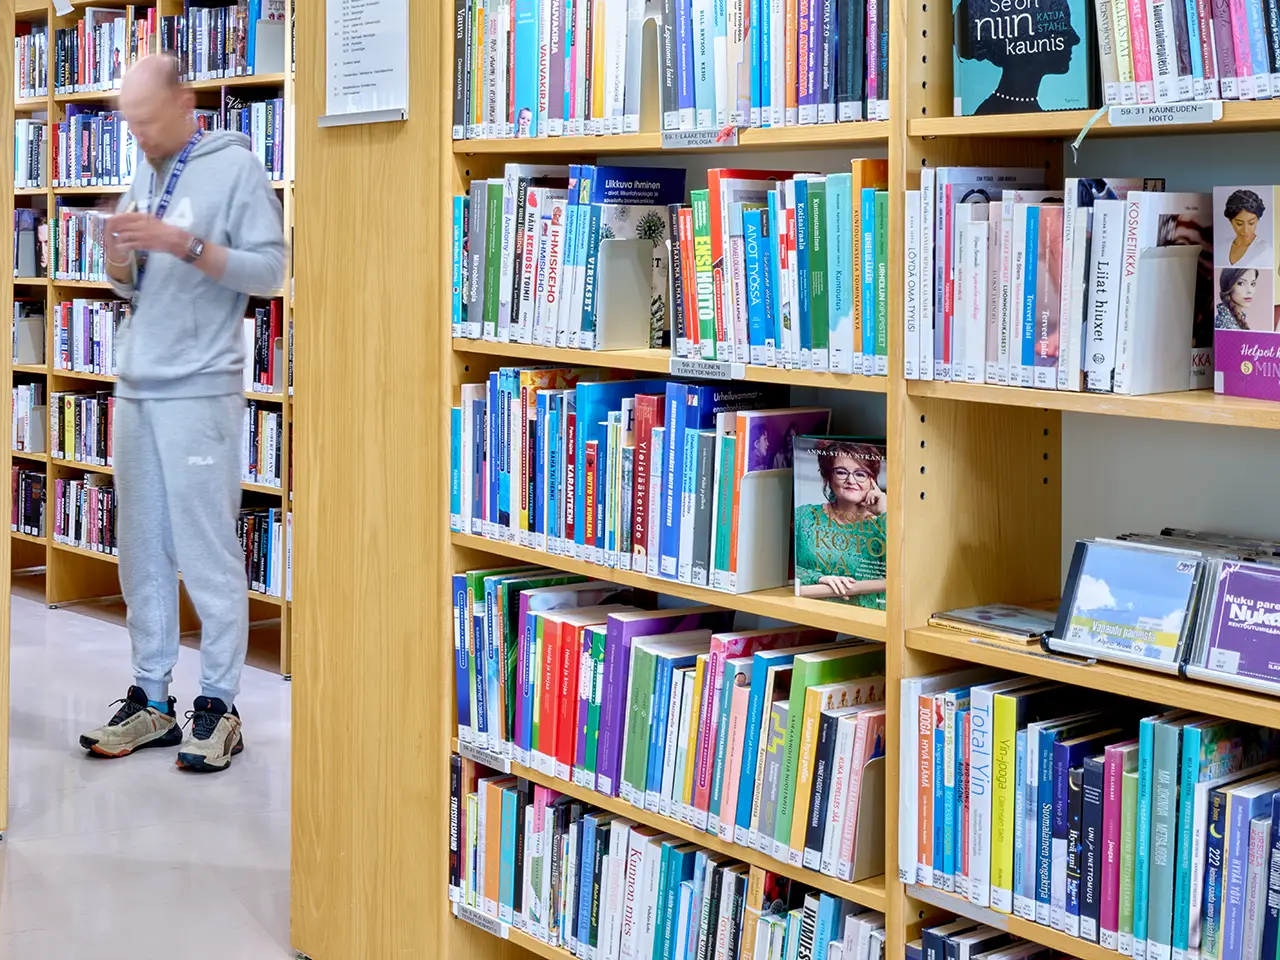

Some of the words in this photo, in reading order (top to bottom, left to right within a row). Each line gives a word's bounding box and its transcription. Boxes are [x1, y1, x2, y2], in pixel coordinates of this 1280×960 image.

[456, 8, 466, 39] Vauva
[800, 19, 809, 32] JA
[974, 12, 1035, 41] niin
[1036, 10, 1065, 21] KATJA
[1097, 0, 1114, 56] kasvojooga
[700, 29, 708, 56] BRYSON
[823, 24, 831, 37] 2.0
[1006, 34, 1065, 55] kaunis
[664, 24, 675, 67] Loputtomat
[539, 43, 548, 113] VAUVAKIRJA
[666, 68, 674, 87] loiset
[799, 34, 809, 97] ANATOMIA
[1120, 106, 1145, 116] 59.31
[1148, 102, 1204, 114] KAUNEUDEN-
[1148, 115, 1174, 123] HOITO
[502, 216, 512, 251] Anatomy
[527, 212, 536, 233] NÄIN
[796, 203, 807, 251] Kotisairaala
[813, 198, 822, 252] Kuntoutuminen
[748, 224, 759, 260] AIVOT
[1124, 201, 1140, 277] KOSMETIIKKA
[501, 252, 510, 277] Trains
[525, 234, 535, 274] KEHOSI
[537, 239, 548, 293] IHMISKEHO
[547, 229, 561, 304] IHMISKEHO
[864, 232, 874, 284] URHEILULÄÄKÄRI
[907, 247, 920, 278] LÖYDÄ
[469, 254, 480, 303] Mikrobiologia
[523, 275, 532, 302] TOIMII
[584, 257, 596, 312] VIRUKSET
[694, 236, 715, 320] ENSIHOITO
[749, 262, 762, 307] TYÖSSÄ
[835, 270, 843, 312] Kuntoutus
[877, 262, 886, 300] URHEILUN
[1096, 260, 1110, 295] Liiat
[908, 280, 917, 304] OMA
[907, 305, 917, 332] TYYLISI
[1027, 294, 1036, 323] Terveet
[1092, 300, 1107, 344] hiuxet
[877, 301, 886, 348] KIPUPISTEET
[1023, 324, 1034, 339] jalat
[1041, 310, 1051, 339] Terveet
[1039, 340, 1050, 359] jalat
[1240, 343, 1275, 360] Helpot
[676, 368, 726, 378] TERVEYDENHOITO
[697, 363, 721, 371] YLEINEN
[854, 451, 887, 462] NYKÄNE
[566, 464, 577, 525] KARANTEENI
[586, 471, 595, 494] VOITTO
[586, 495, 594, 506] TAI
[586, 507, 594, 538] KUOLEMA
[814, 530, 886, 558] KOTO
[814, 551, 852, 576] NA
[1225, 593, 1254, 607] Nuku
[1091, 618, 1123, 638] Vapaudu
[544, 643, 554, 663] Hoida
[563, 648, 572, 667] Hoida
[544, 672, 553, 690] kirjaa
[562, 676, 570, 696] kirjaa
[919, 705, 931, 736] JOOGA
[971, 704, 990, 756] Total
[921, 739, 930, 759] HYVÄ
[836, 756, 845, 776] KUKA
[920, 760, 930, 788] ELÄMÄ
[996, 739, 1011, 790] Yin-jooga
[971, 762, 989, 796] Yin
[450, 796, 460, 851] STRESSITASAPAINO
[832, 809, 840, 823] JÄÄ
[1040, 802, 1053, 853] Suomalainen
[552, 834, 561, 861] Saunan
[1068, 829, 1079, 852] Hyvä
[1087, 827, 1095, 842] UNI
[1069, 853, 1077, 869] uni
[1208, 847, 1221, 866] 222
[551, 862, 560, 885] taikaa
[625, 847, 644, 901] Kunnon
[1039, 855, 1052, 899] joogakirja
[1086, 852, 1095, 903] UNETTOMUUS
[1230, 859, 1243, 883] HYVÄÄ
[1230, 886, 1242, 904] YÖTÄ
[623, 906, 636, 937] mies
